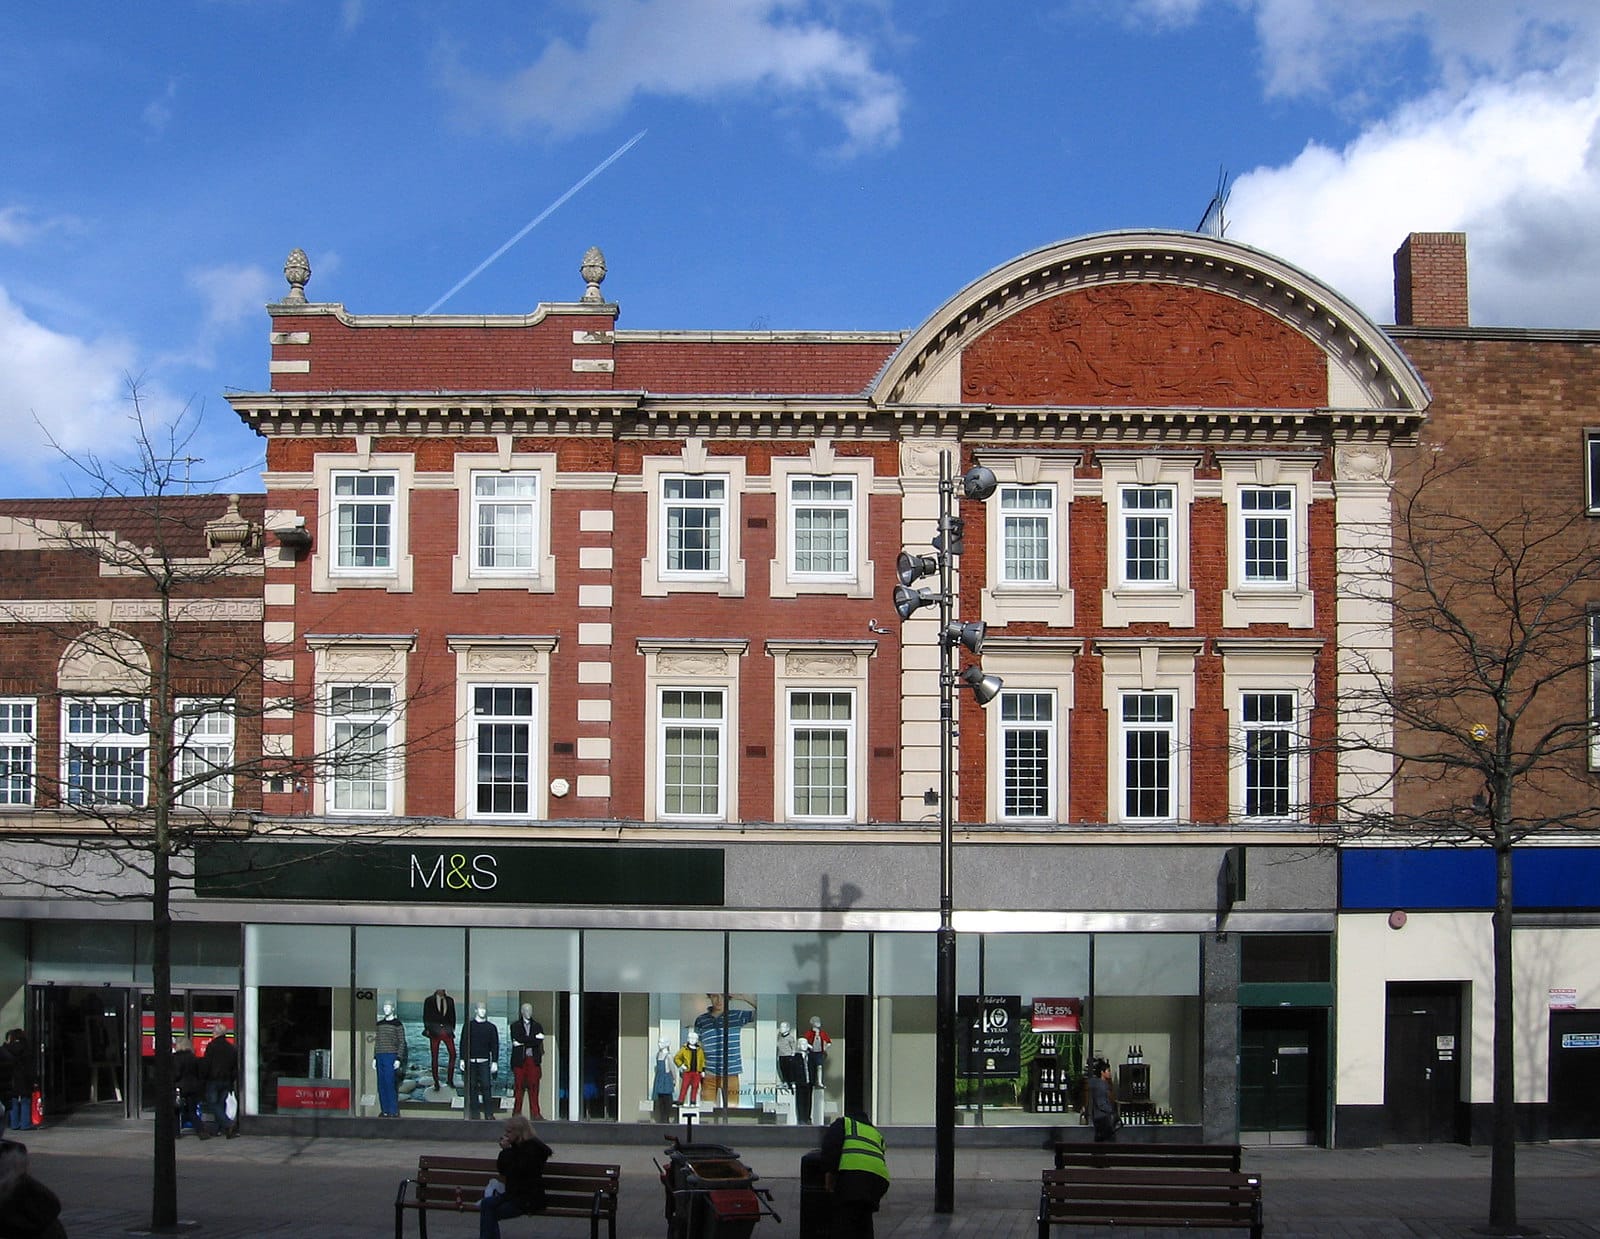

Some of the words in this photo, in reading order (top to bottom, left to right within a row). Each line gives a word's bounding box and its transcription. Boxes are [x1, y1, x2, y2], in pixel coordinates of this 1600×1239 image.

[410, 854, 497, 890] M&S
[356, 991, 373, 1000] GQ
[1034, 1006, 1054, 1015] SAVE
[1054, 1006, 1072, 1015] 25%
[315, 1089, 331, 1098] OFF
